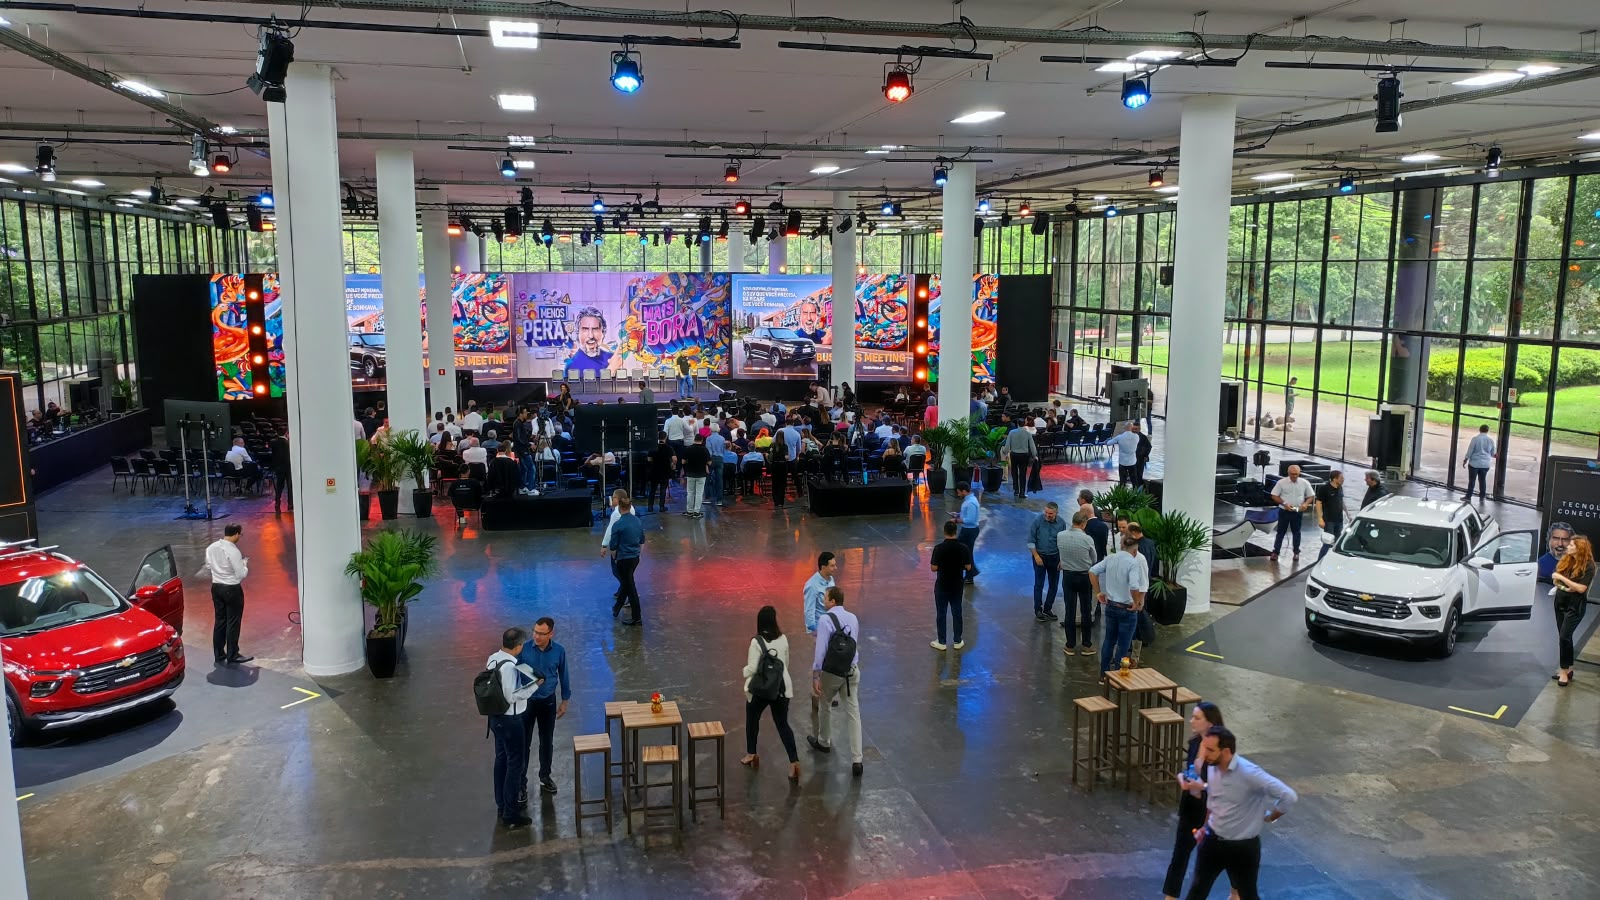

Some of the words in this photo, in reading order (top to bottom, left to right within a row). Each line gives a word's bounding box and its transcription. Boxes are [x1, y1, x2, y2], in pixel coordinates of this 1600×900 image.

[540, 308, 566, 319] MENOS
[643, 300, 674, 321] MAIS
[647, 311, 700, 346] BORA
[467, 355, 509, 366] MEETING
[864, 353, 905, 363] MEETING
[1561, 500, 1600, 511] TECNOL
